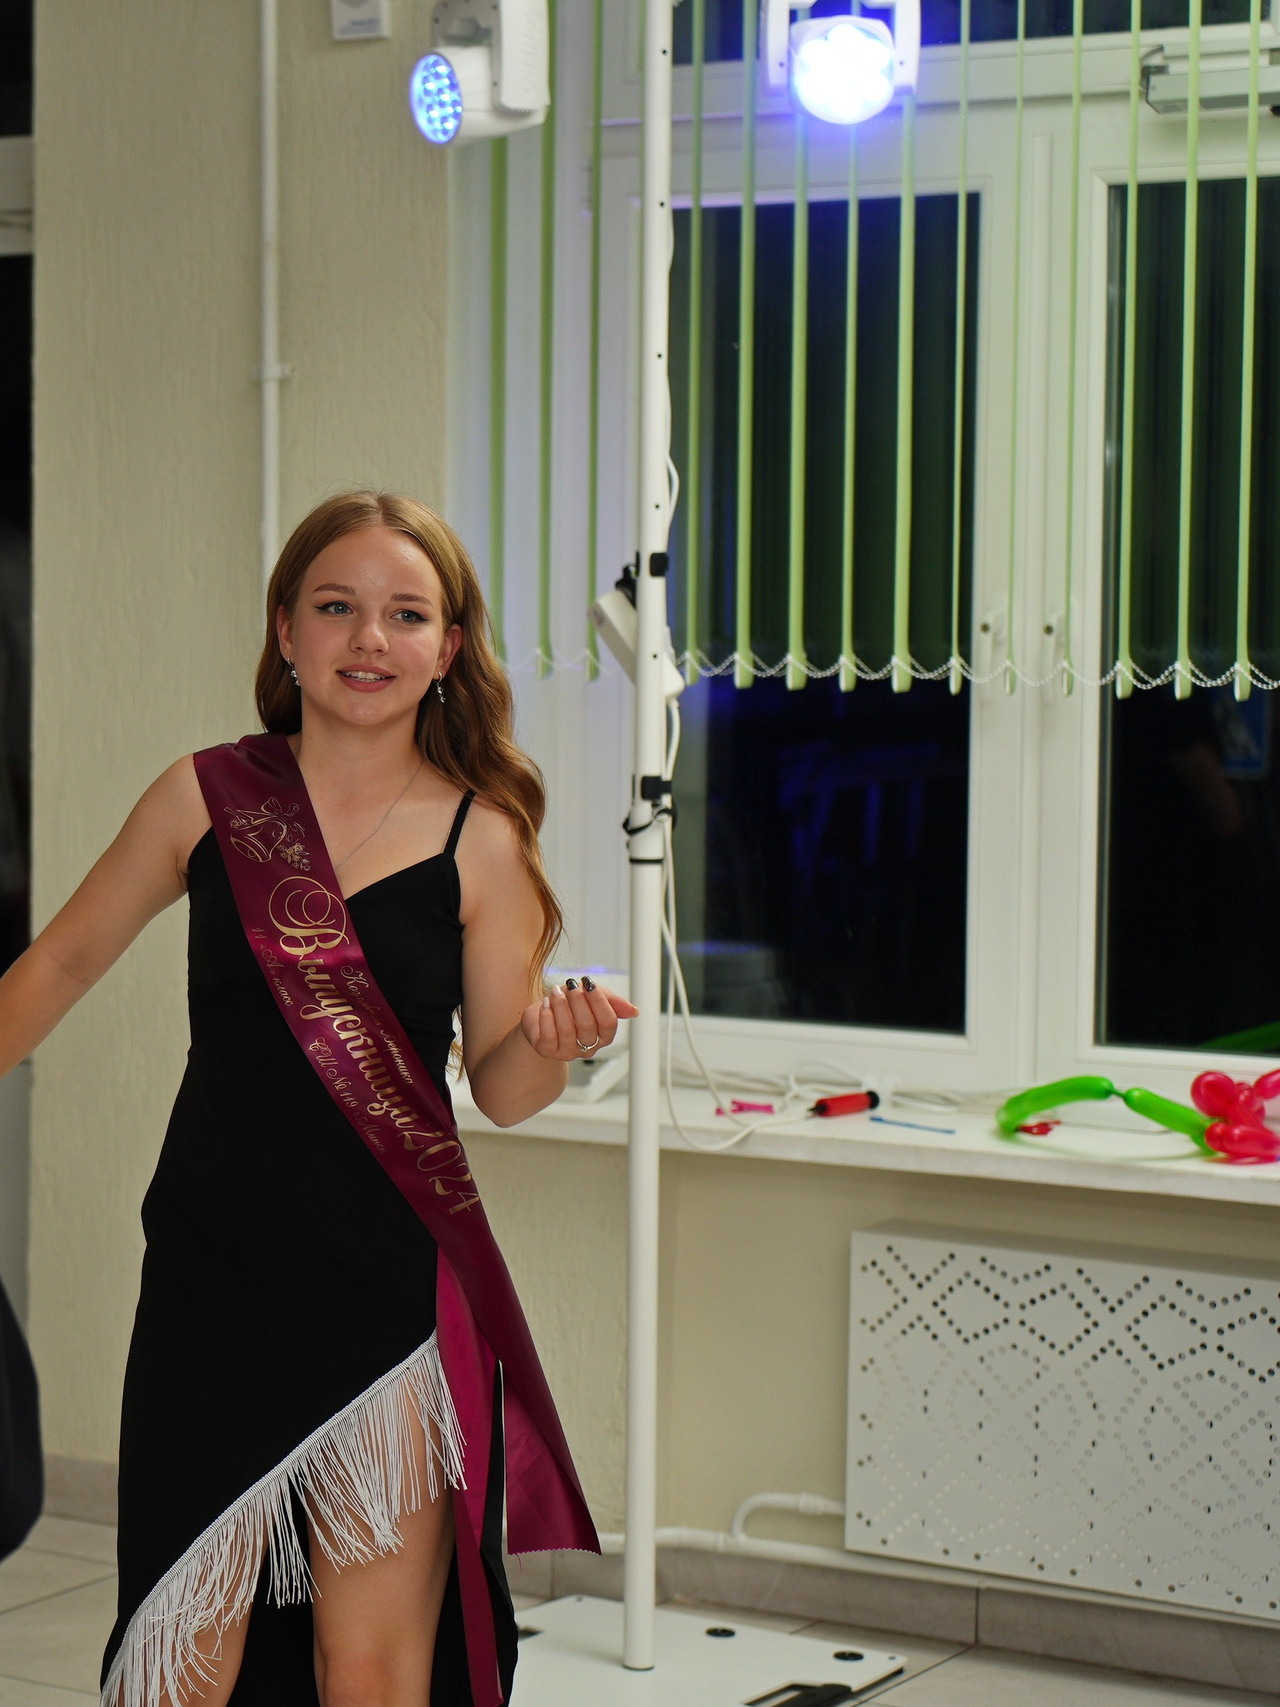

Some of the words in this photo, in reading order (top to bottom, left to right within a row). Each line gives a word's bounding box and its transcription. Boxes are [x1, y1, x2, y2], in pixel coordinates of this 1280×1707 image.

[272, 977, 294, 1007] класс
[268, 875, 419, 1130] Выпускница
[397, 1122, 480, 1215] 2024
[380, 1028, 414, 1084] Вероника
